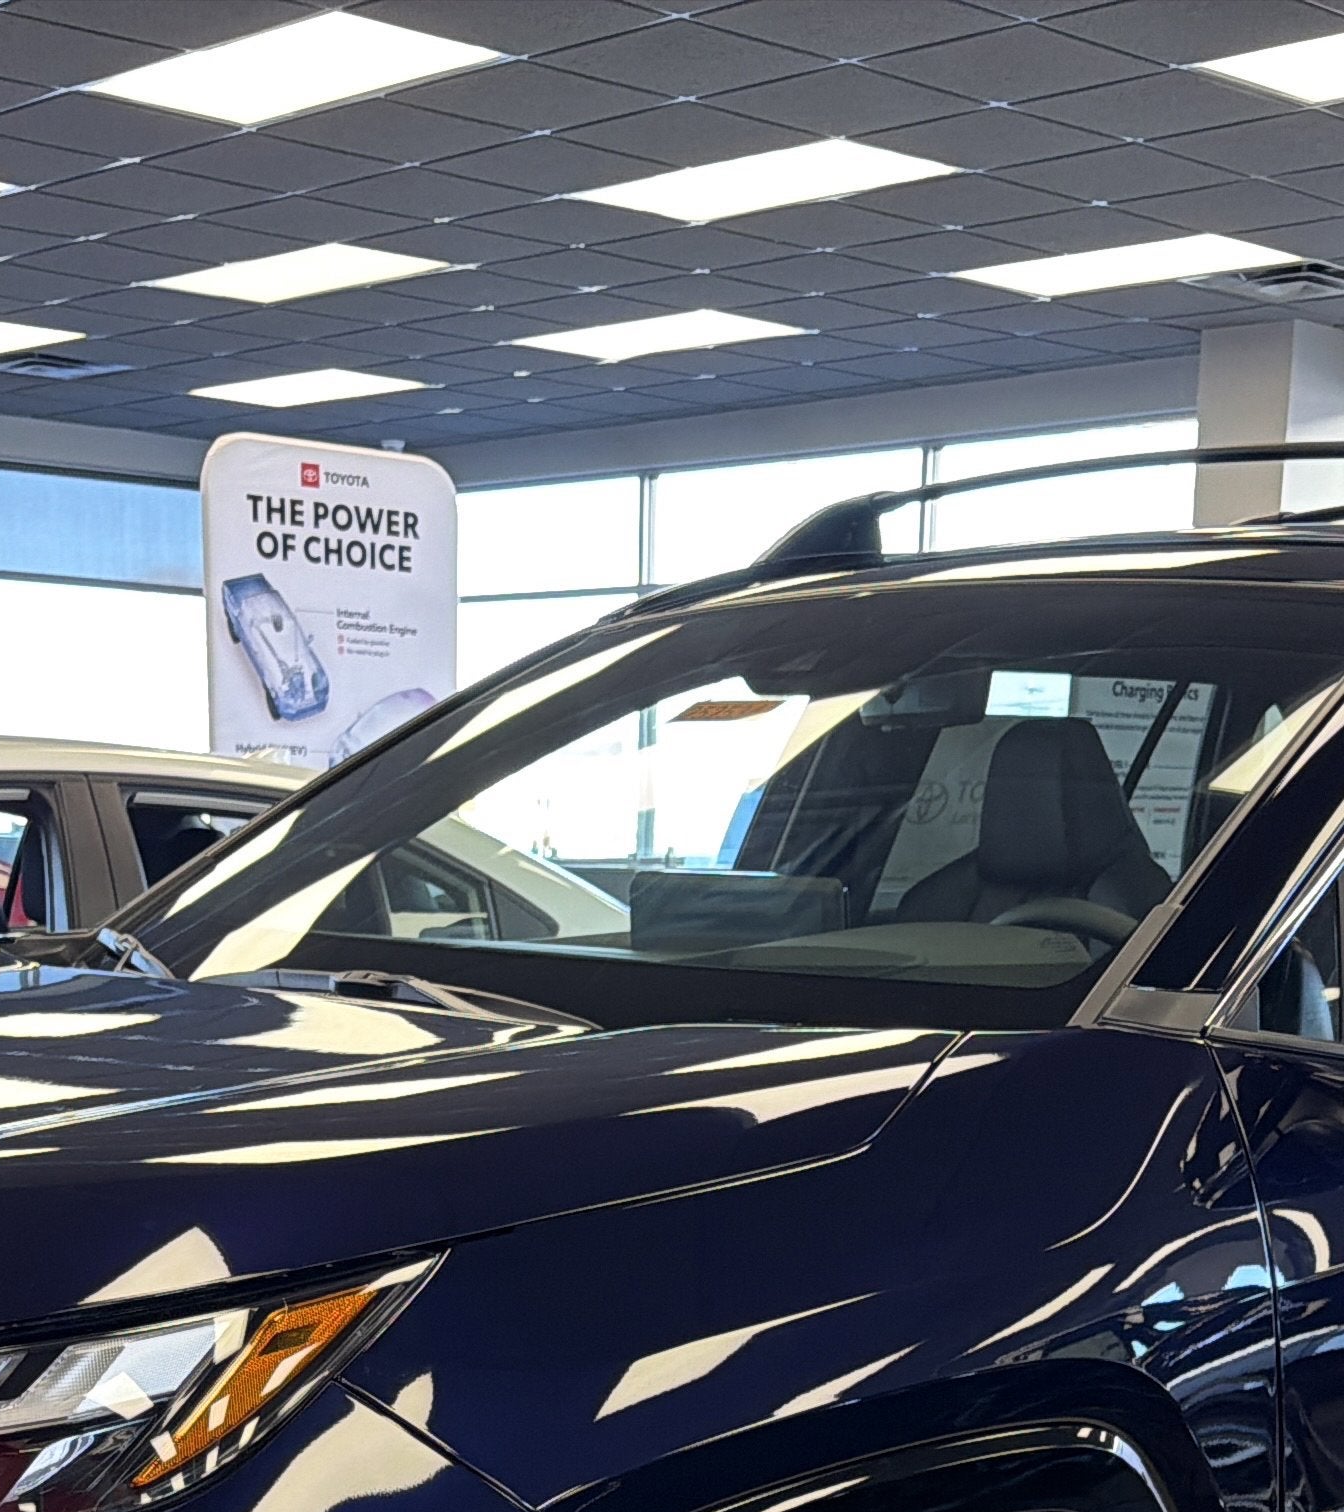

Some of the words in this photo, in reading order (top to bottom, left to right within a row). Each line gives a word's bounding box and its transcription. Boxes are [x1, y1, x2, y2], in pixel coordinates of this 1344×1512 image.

[324, 472, 370, 488] TOYOTA
[246, 493, 305, 527] THE
[313, 501, 420, 540] POWER
[256, 531, 296, 561] OF
[304, 535, 412, 573] CHOICE
[336, 608, 370, 620] Internal
[336, 620, 387, 633] Combustion
[389, 624, 418, 638] Engine
[1112, 681, 1164, 703] Charging
